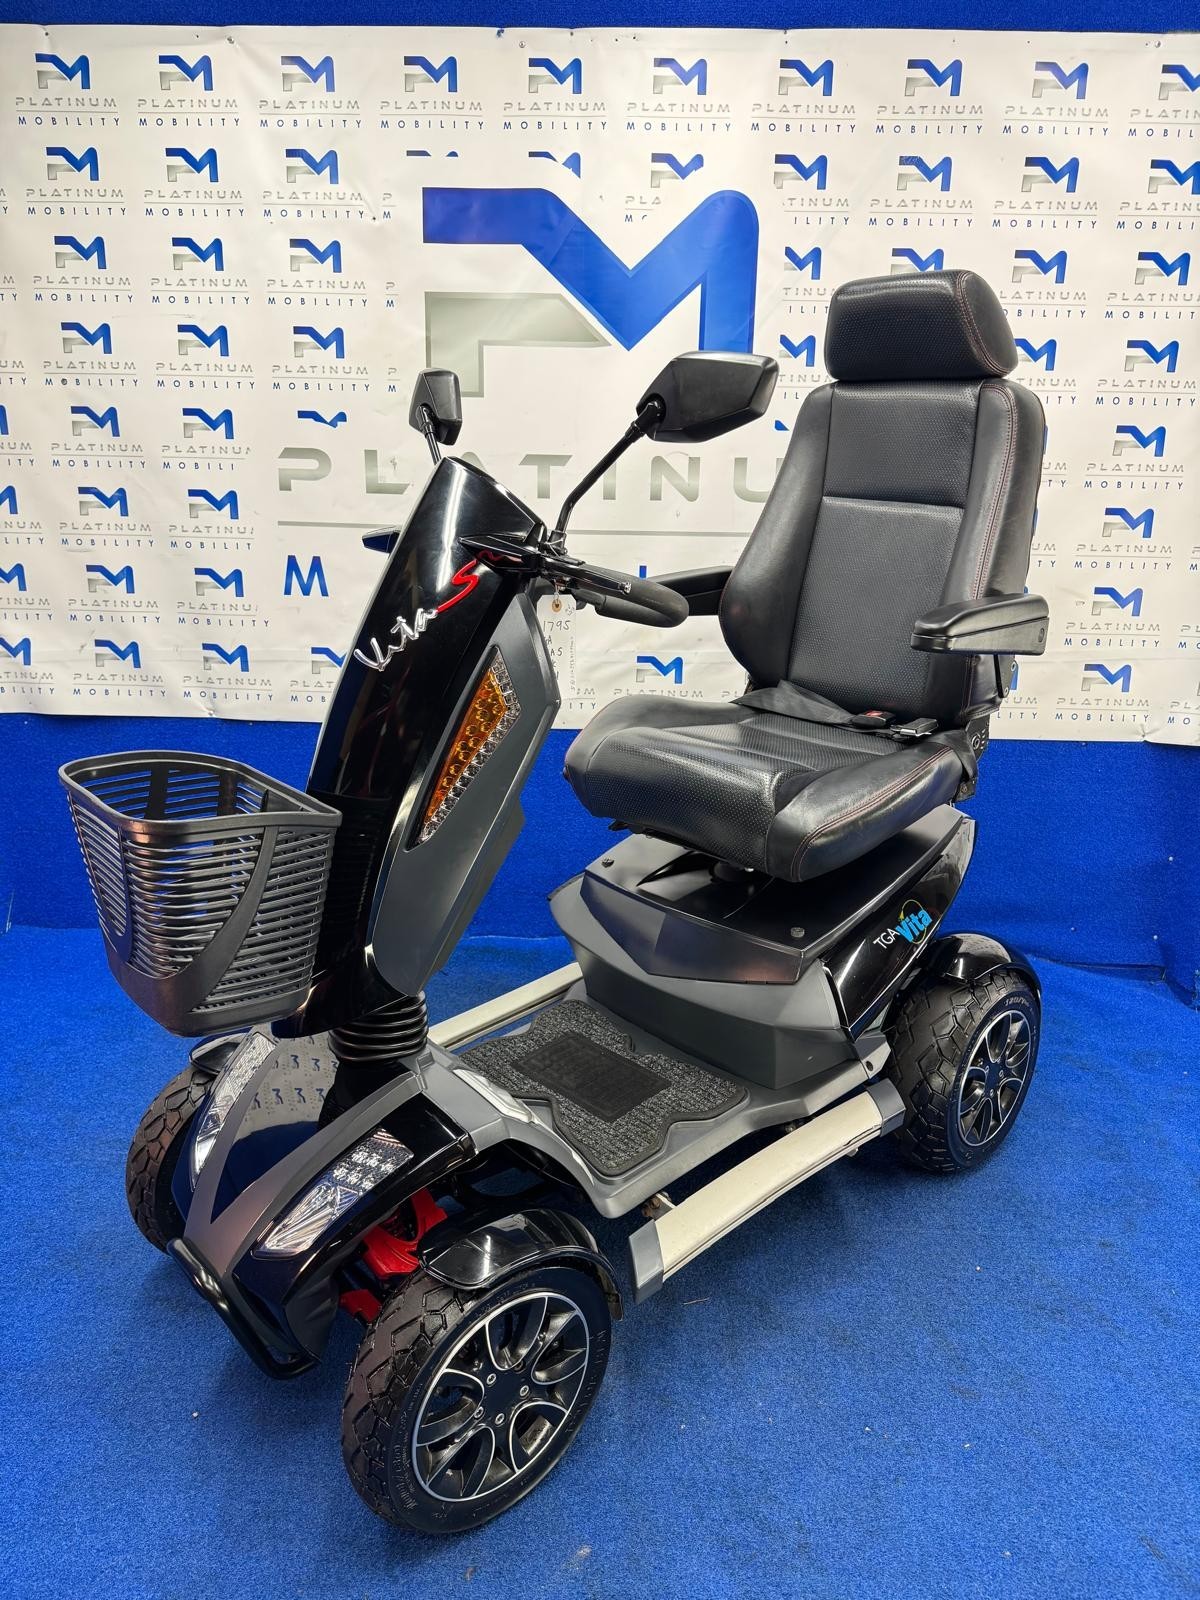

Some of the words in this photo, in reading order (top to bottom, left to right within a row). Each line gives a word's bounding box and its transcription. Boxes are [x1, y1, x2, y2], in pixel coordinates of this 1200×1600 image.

[15, 97, 117, 107] PLATINUM
[137, 99, 238, 108] PLATINUM
[259, 100, 360, 110] PLATINUM
[380, 100, 482, 111] PLATINUM
[503, 102, 605, 111] PLATINUM
[627, 102, 730, 113] PLATINUM
[752, 103, 855, 114] PLATINUM
[877, 105, 983, 115] PLATINUM
[1005, 106, 1108, 117] PLATINUM
[1130, 109, 1200, 119] PLATIN
[18, 116, 119, 126] MOBILITY
[139, 117, 240, 127] MOBILITY
[260, 119, 361, 128] MOBILITY
[380, 120, 484, 130] MOBILITY
[503, 121, 607, 131] MOBILITY
[626, 121, 731, 132] MOBILITY
[750, 122, 856, 133] MOBILITY
[875, 124, 983, 134] MOBILITY
[1002, 125, 1109, 136] MOBILITY
[1128, 128, 1194, 138] MOBIL
[26, 188, 124, 198] PLATINUM
[144, 190, 242, 199] PLATINUM
[263, 191, 363, 201] PLATINUM
[786, 198, 849, 207] TINUM
[870, 199, 973, 209] PLATINUM
[994, 200, 1098, 210] PLATINUM
[28, 206, 126, 216] MOBILITY
[145, 208, 244, 217] MOBILITY
[263, 209, 364, 219] MOBILITY
[794, 216, 850, 225] ILITY
[868, 217, 973, 227] MOBILITY
[992, 219, 1097, 229] MOBILITY
[1116, 220, 1194, 230] MOBILI
[33, 275, 131, 286] PLATINUM
[151, 278, 248, 287] PLATINUM
[267, 279, 366, 289] PLATINUM
[35, 293, 133, 303] MOBILITY
[151, 295, 250, 305] MOBILITY
[1000, 290, 1086, 300] LATINUM
[1107, 292, 1200, 302] PLATINU
[268, 297, 367, 307] MOBILITY
[1104, 310, 1195, 320] MOBILIT
[43, 361, 136, 370] PLATINUM
[156, 362, 253, 373] PLATINUM
[272, 365, 368, 375] PLATINUM
[45, 377, 138, 387] MOBILITY
[157, 379, 255, 390] MOBILITY
[272, 382, 370, 392] MOBILITY
[1016, 378, 1076, 387] TINUM
[1097, 379, 1196, 389] PLATINUM
[1095, 396, 1196, 407] MOBILITY
[51, 443, 143, 452] PLATINUM
[52, 459, 146, 469] MOBILITY
[163, 461, 234, 471] MOBILI
[1087, 463, 1184, 472] PLATINUM
[1084, 480, 1183, 490] MOBILITY
[59, 522, 151, 532] PLATINUM
[169, 525, 254, 535] PLATINU
[61, 538, 154, 547] MOBILITY
[170, 540, 251, 550] MOBILIT
[1076, 544, 1172, 553] PLATINUM
[1074, 561, 1171, 570] MOBILITY
[68, 599, 158, 608] PLATINUM
[177, 601, 258, 612] PLATINU
[4, 612, 53, 621] ILITY
[70, 614, 160, 623] MOBILITY
[178, 617, 269, 627] MOBILITY
[1066, 622, 1160, 631] PLATINUM
[1064, 638, 1160, 647] MOBILITY
[73, 673, 163, 683] PLATINUM
[183, 676, 270, 686] PLATINUM
[0, 686, 54, 694] BILITY
[73, 688, 166, 697] MOBILITY
[183, 691, 273, 701] MOBILITY
[1057, 698, 1149, 707] PLATINUM
[1055, 713, 1149, 722] MOBILITY
[872, 928, 901, 949] TGA
[895, 909, 933, 943] Vita
